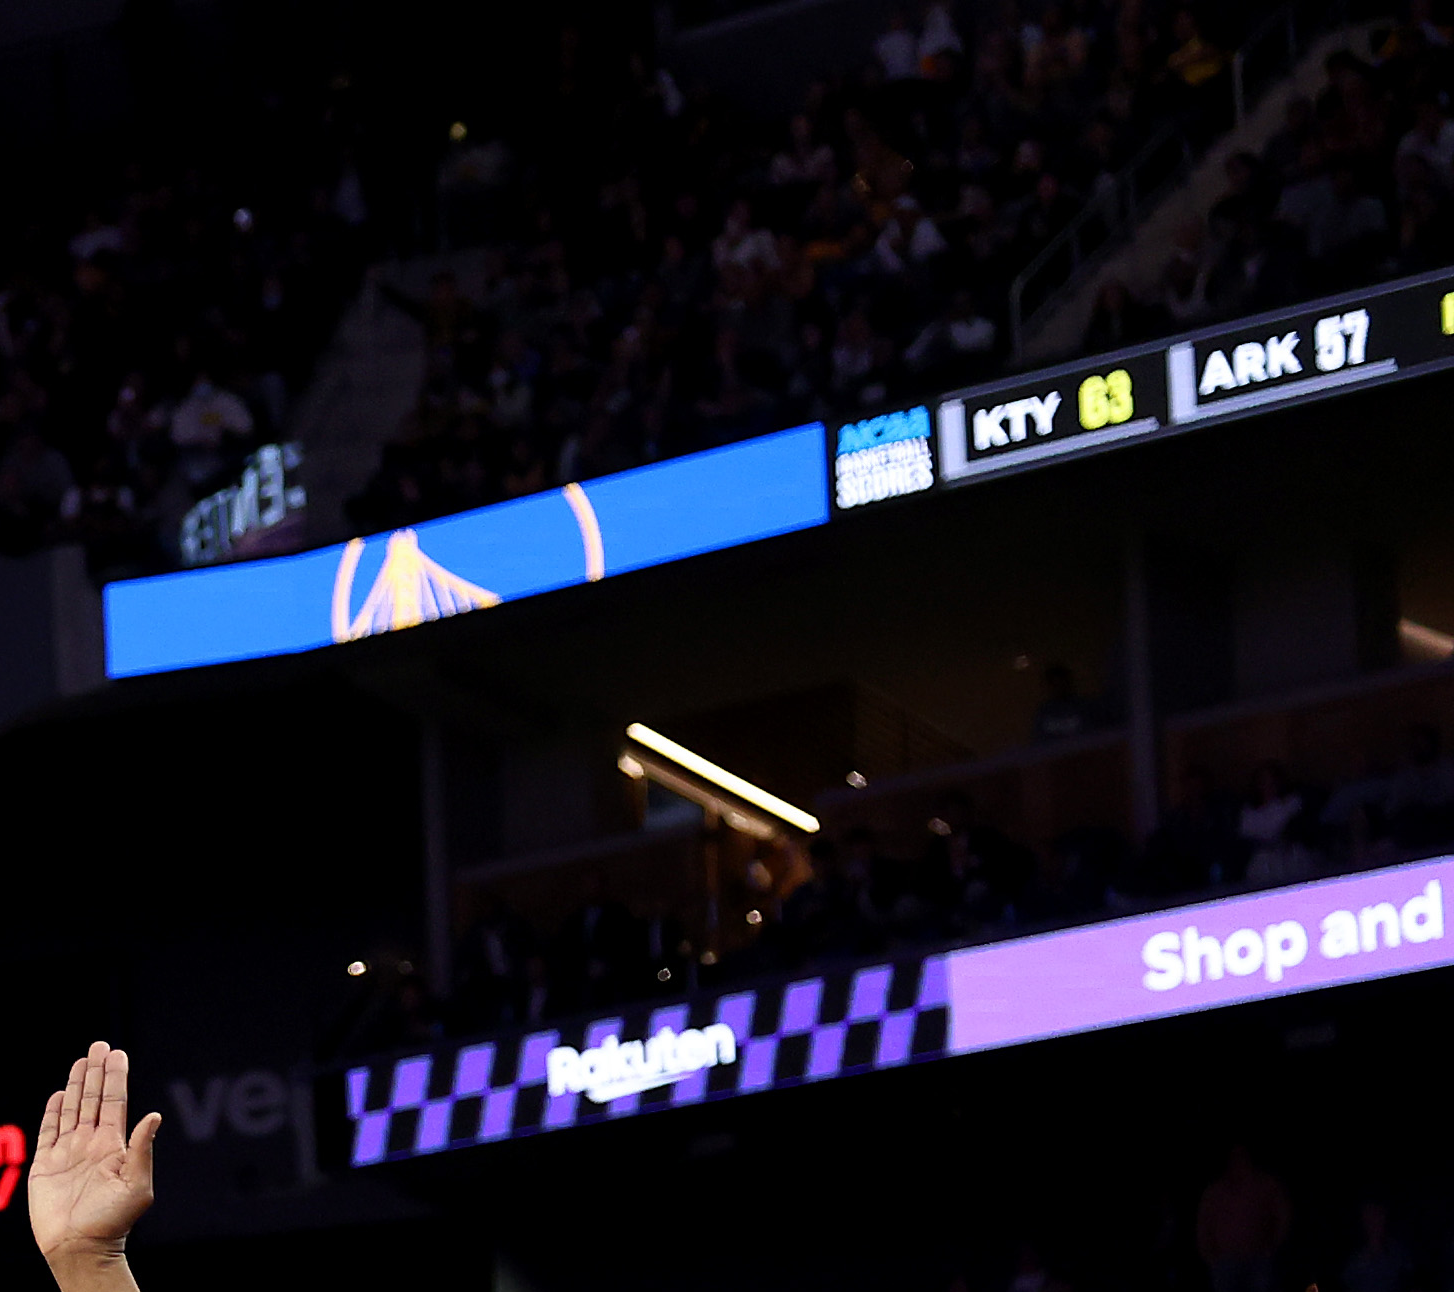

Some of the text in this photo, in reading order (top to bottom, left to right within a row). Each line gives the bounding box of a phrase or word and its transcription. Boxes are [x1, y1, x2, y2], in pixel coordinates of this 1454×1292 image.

[1200, 331, 1302, 395] ARK
[1314, 309, 1371, 371] 57
[974, 369, 1135, 450] KTY 63
[1143, 881, 1443, 990] Shop and
[547, 1023, 736, 1102] Rakuten
